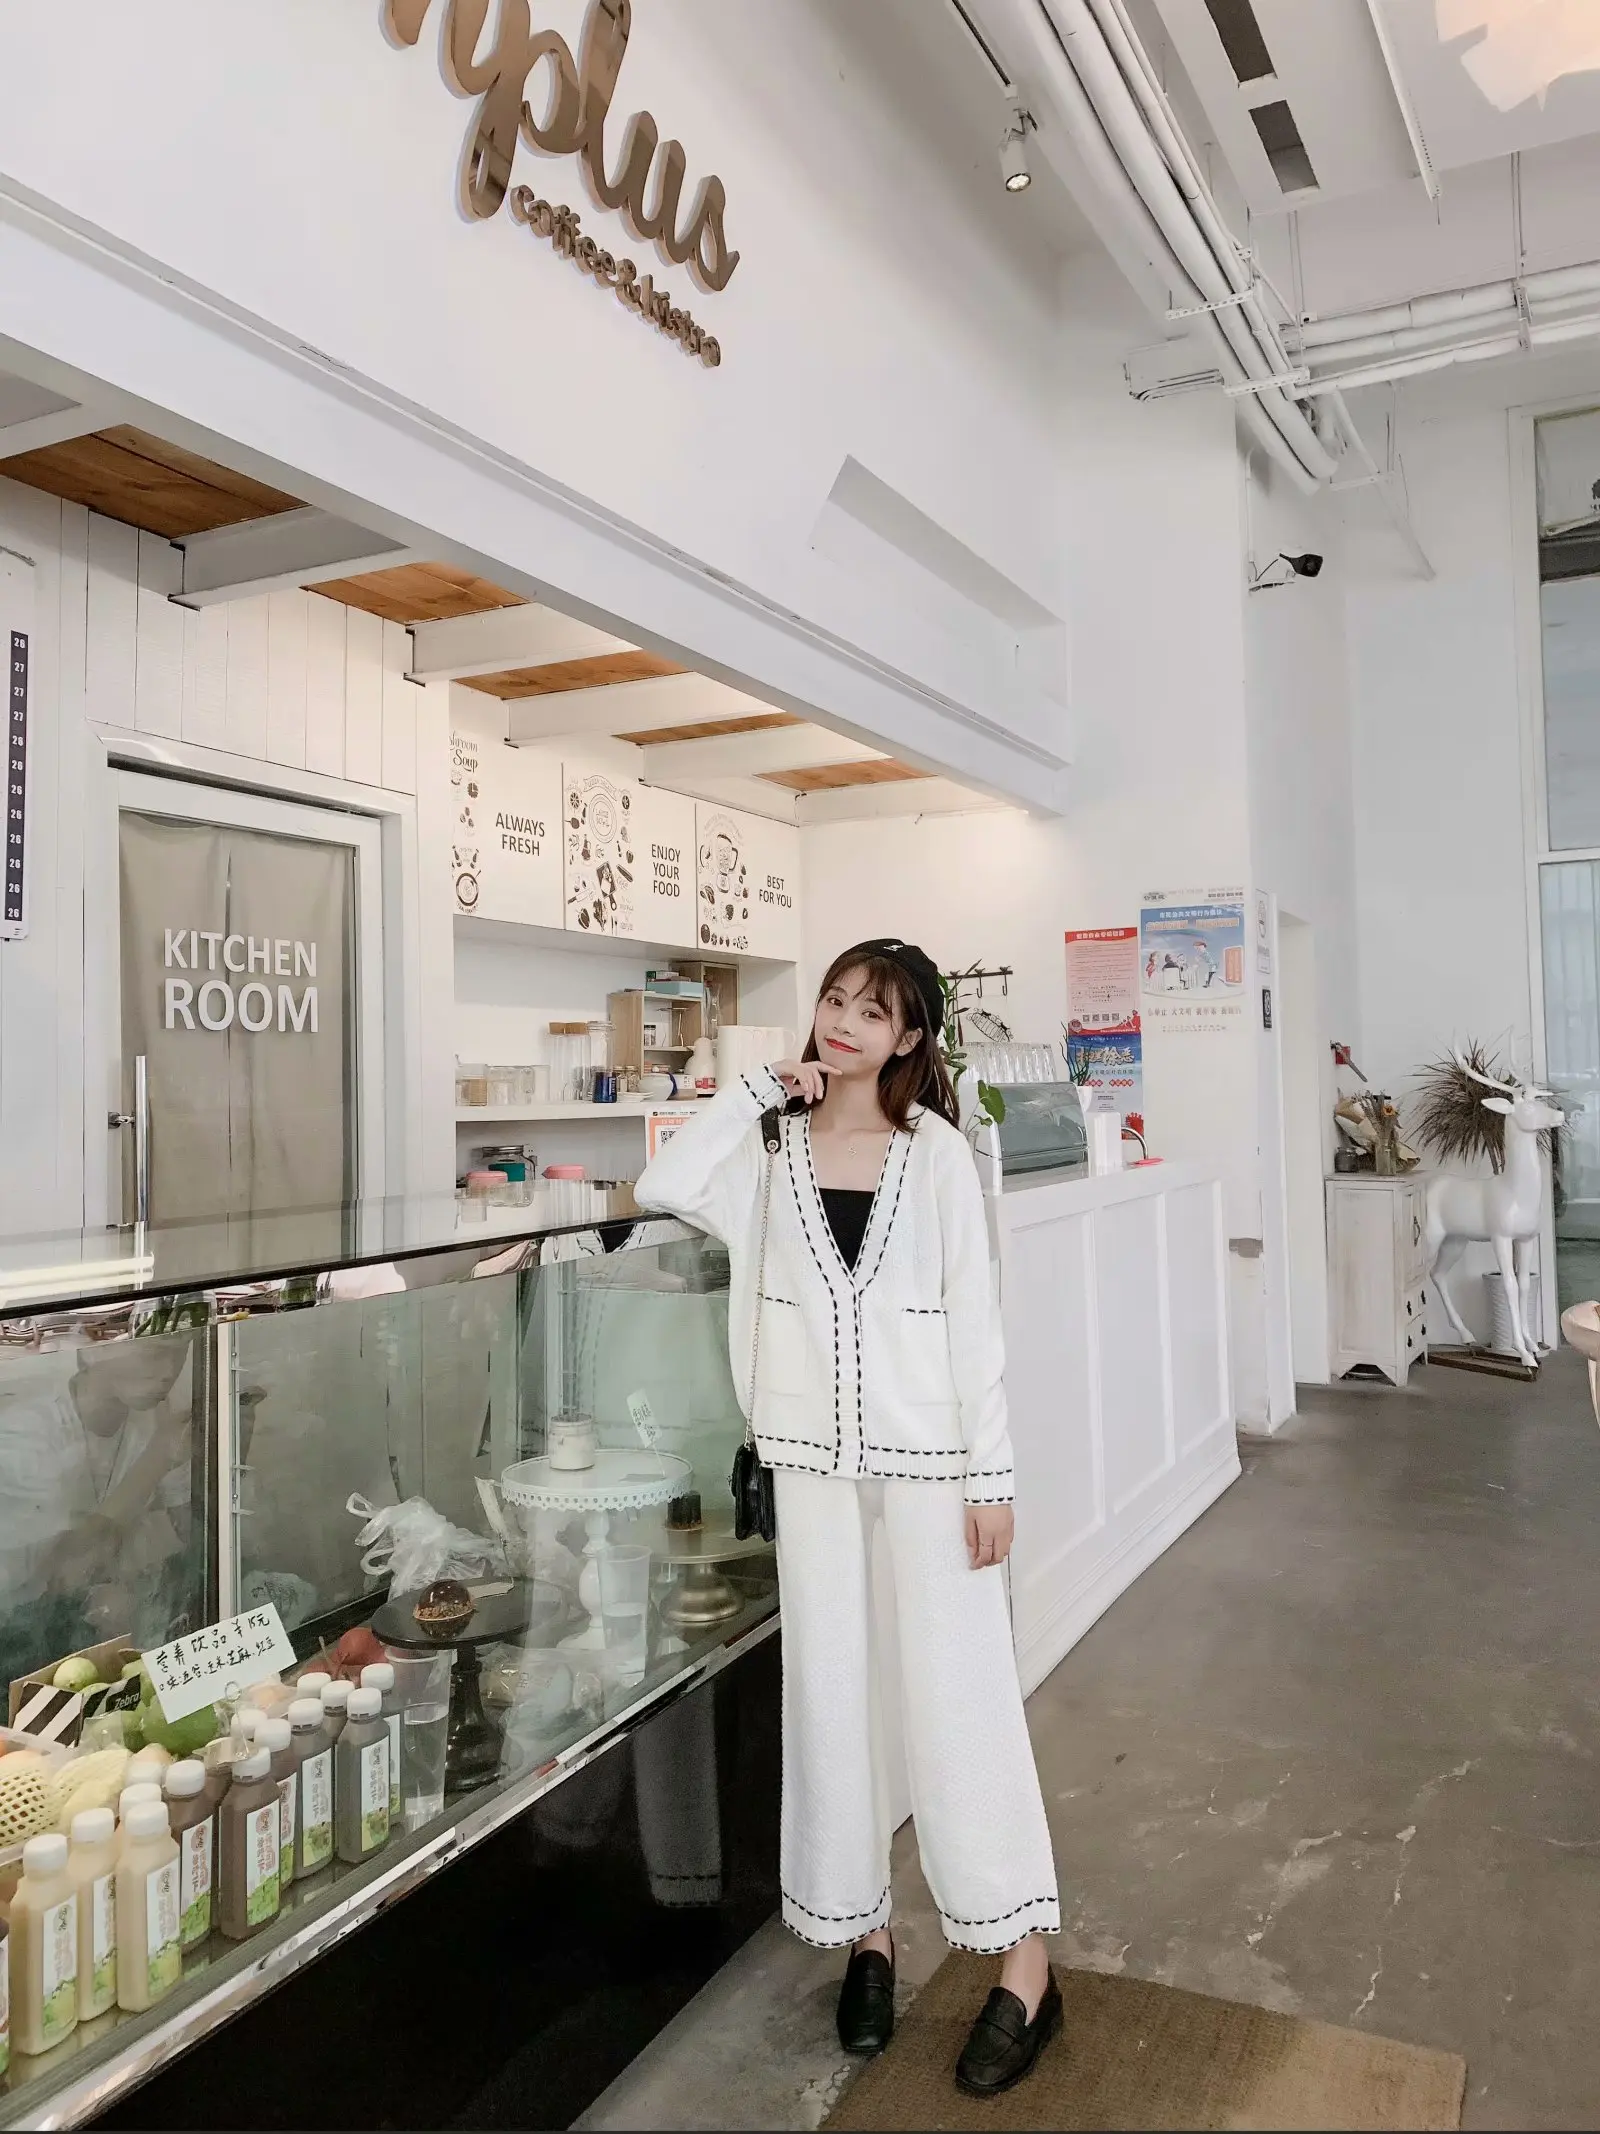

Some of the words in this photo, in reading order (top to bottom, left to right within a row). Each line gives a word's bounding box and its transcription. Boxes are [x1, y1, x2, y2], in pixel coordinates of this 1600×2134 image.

[14, 637, 26, 649] 26
[14, 661, 25, 673] 27
[13, 686, 24, 698] 27
[13, 710, 24, 722] 27
[11, 735, 24, 747] 26
[11, 759, 23, 771] 26
[453, 748, 479, 773] Soup
[10, 784, 23, 796] 26
[9, 808, 22, 820] 26
[495, 812, 546, 838] ALWAYS
[9, 833, 22, 845] 26
[501, 833, 540, 857] FRESH
[651, 843, 681, 863] ENJOY
[8, 858, 21, 869] 26
[652, 861, 680, 881] YOUR
[8, 882, 21, 894] 26
[653, 879, 681, 898] FOOD
[766, 874, 785, 891] BEST
[759, 888, 775, 905] FOR
[776, 893, 792, 909] YOU
[7, 907, 20, 919] 26
[164, 928, 317, 977] KITCHEN
[164, 978, 319, 1033] ROOM
[115, 1692, 139, 1710] Zebra
